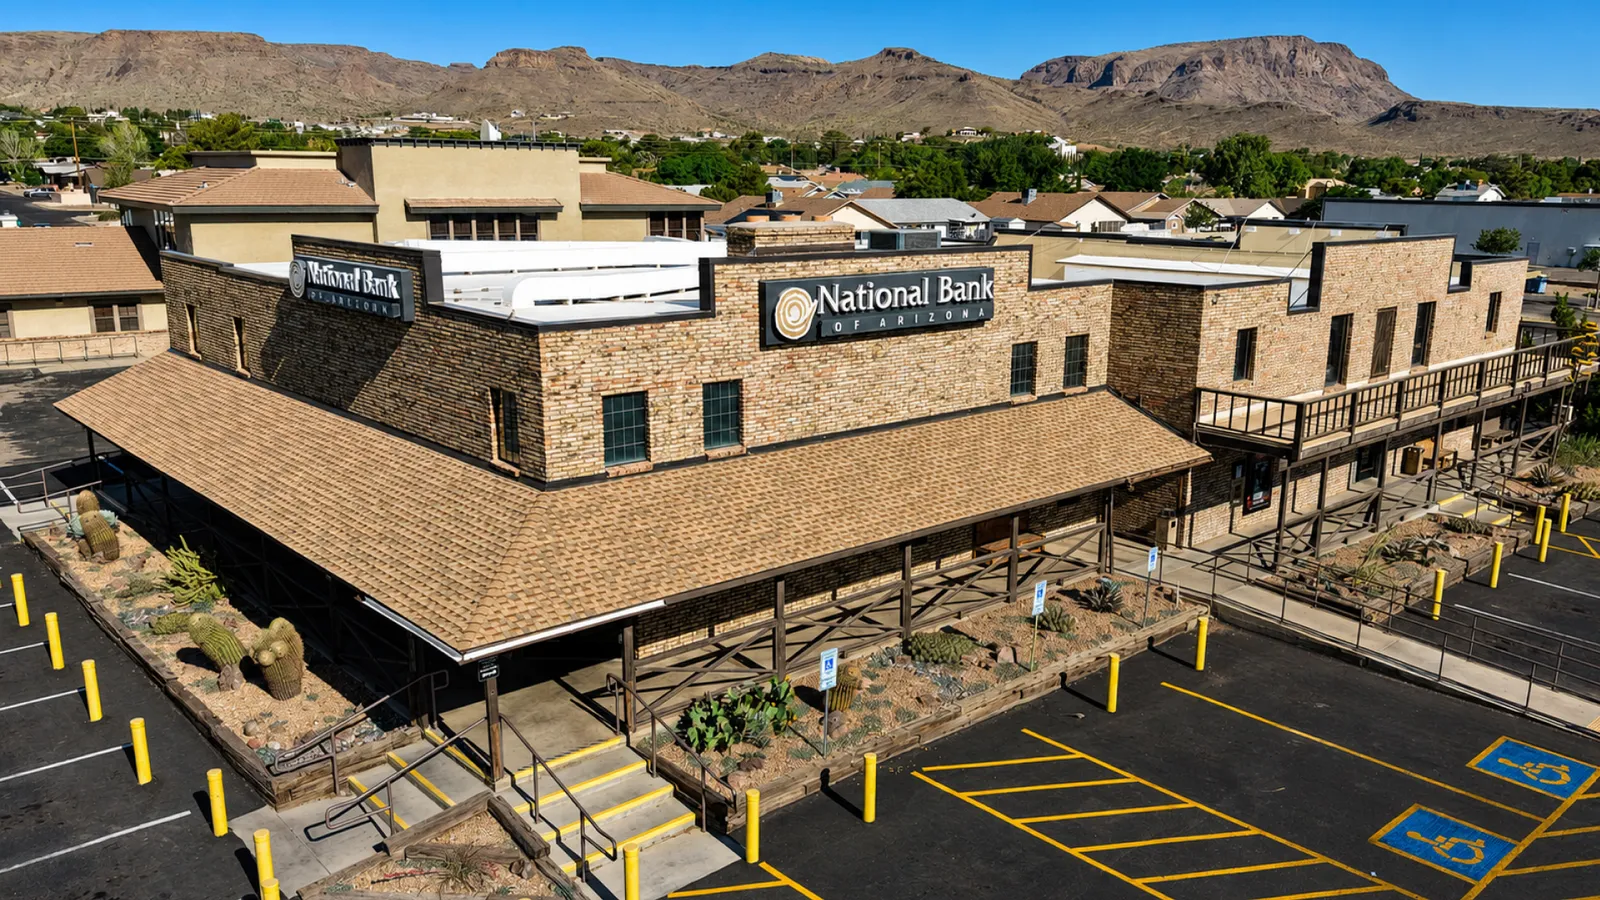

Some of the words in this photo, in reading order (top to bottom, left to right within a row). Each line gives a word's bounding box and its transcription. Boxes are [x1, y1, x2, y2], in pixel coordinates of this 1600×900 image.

[307, 261, 361, 292] National
[363, 269, 400, 299] Bank
[817, 277, 930, 315] National
[937, 273, 994, 303] Bank
[835, 320, 861, 333] OF
[879, 308, 985, 327] ARIZONA
